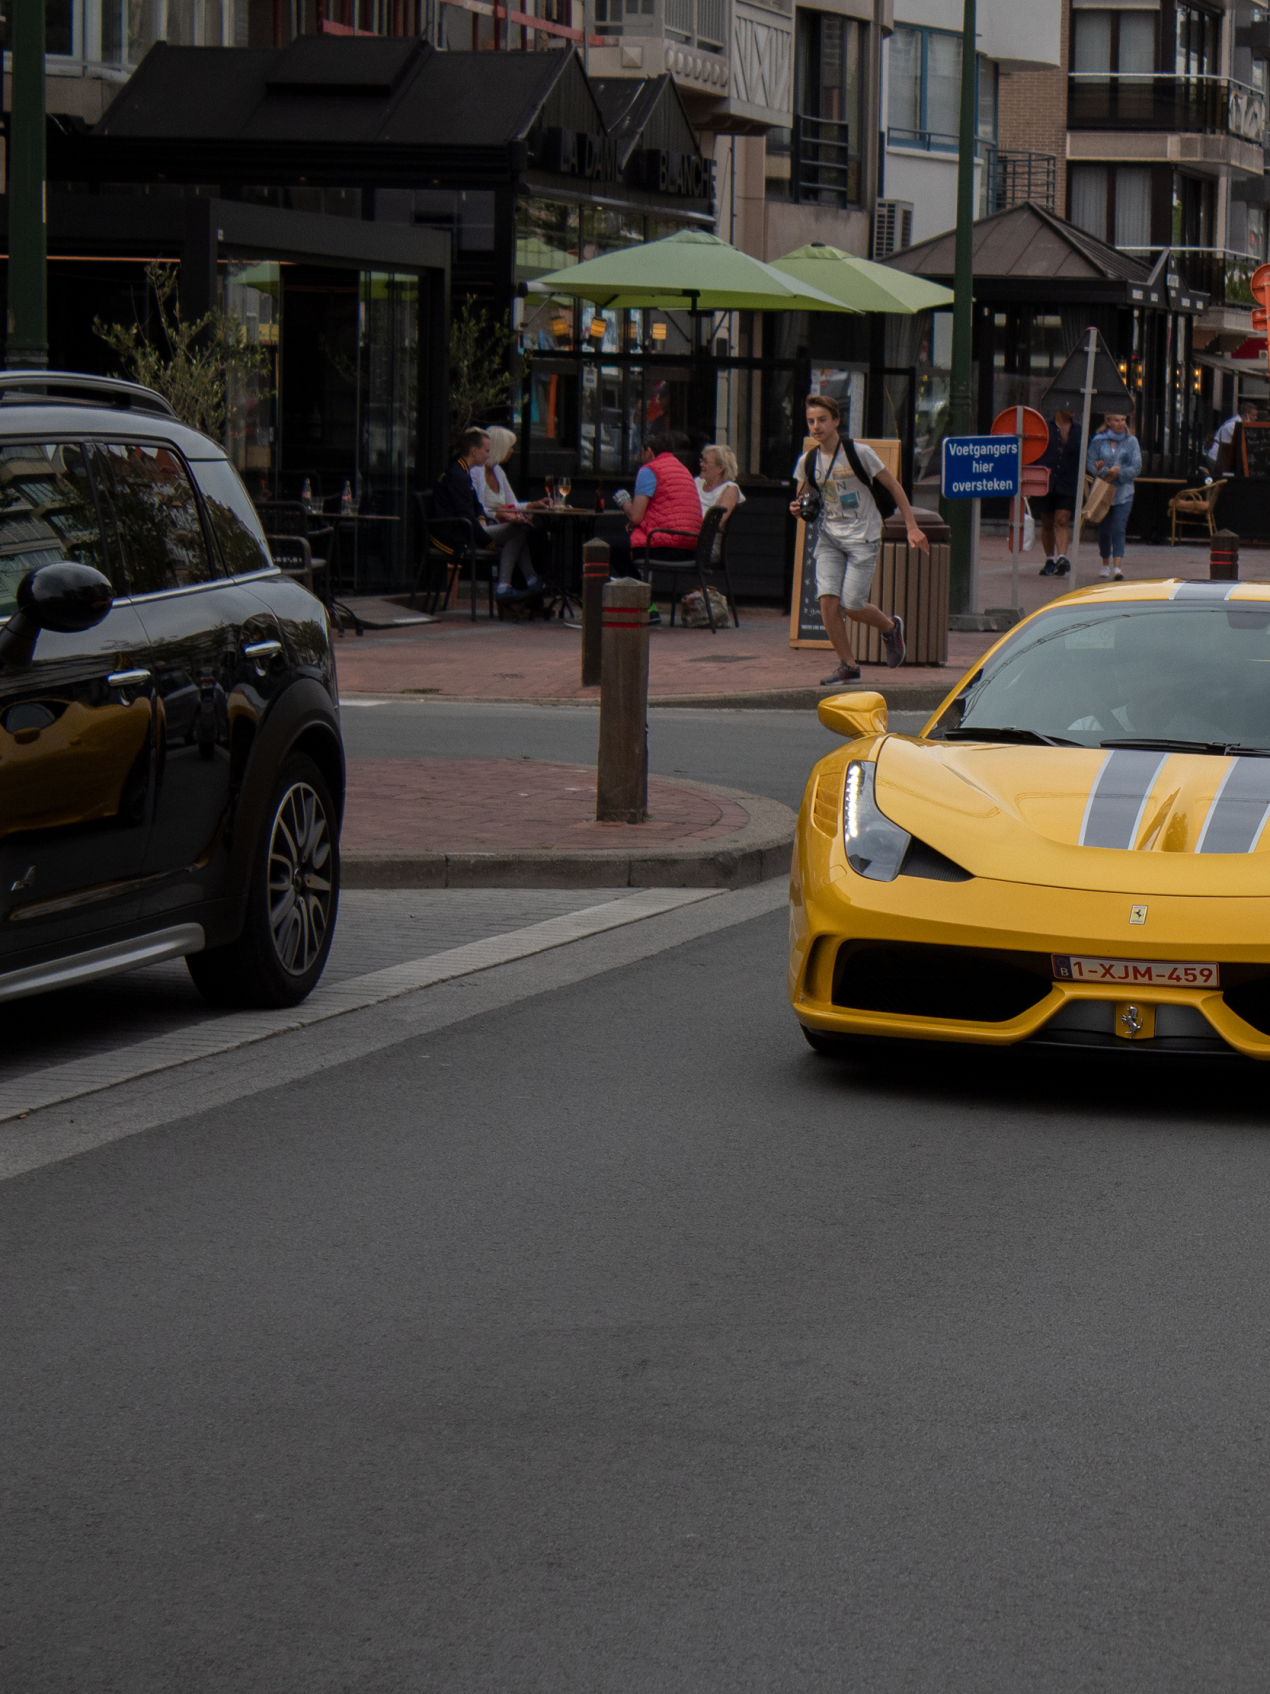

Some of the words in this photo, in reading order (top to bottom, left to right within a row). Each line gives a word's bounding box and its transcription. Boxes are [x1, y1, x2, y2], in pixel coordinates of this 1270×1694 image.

[660, 150, 717, 200] BLANCHE
[949, 443, 1018, 458] Voetgangers
[972, 461, 994, 473] hier
[952, 478, 1013, 492] oversteken
[1060, 967, 1069, 977] B
[1073, 961, 1214, 983] 1-XJM-459
